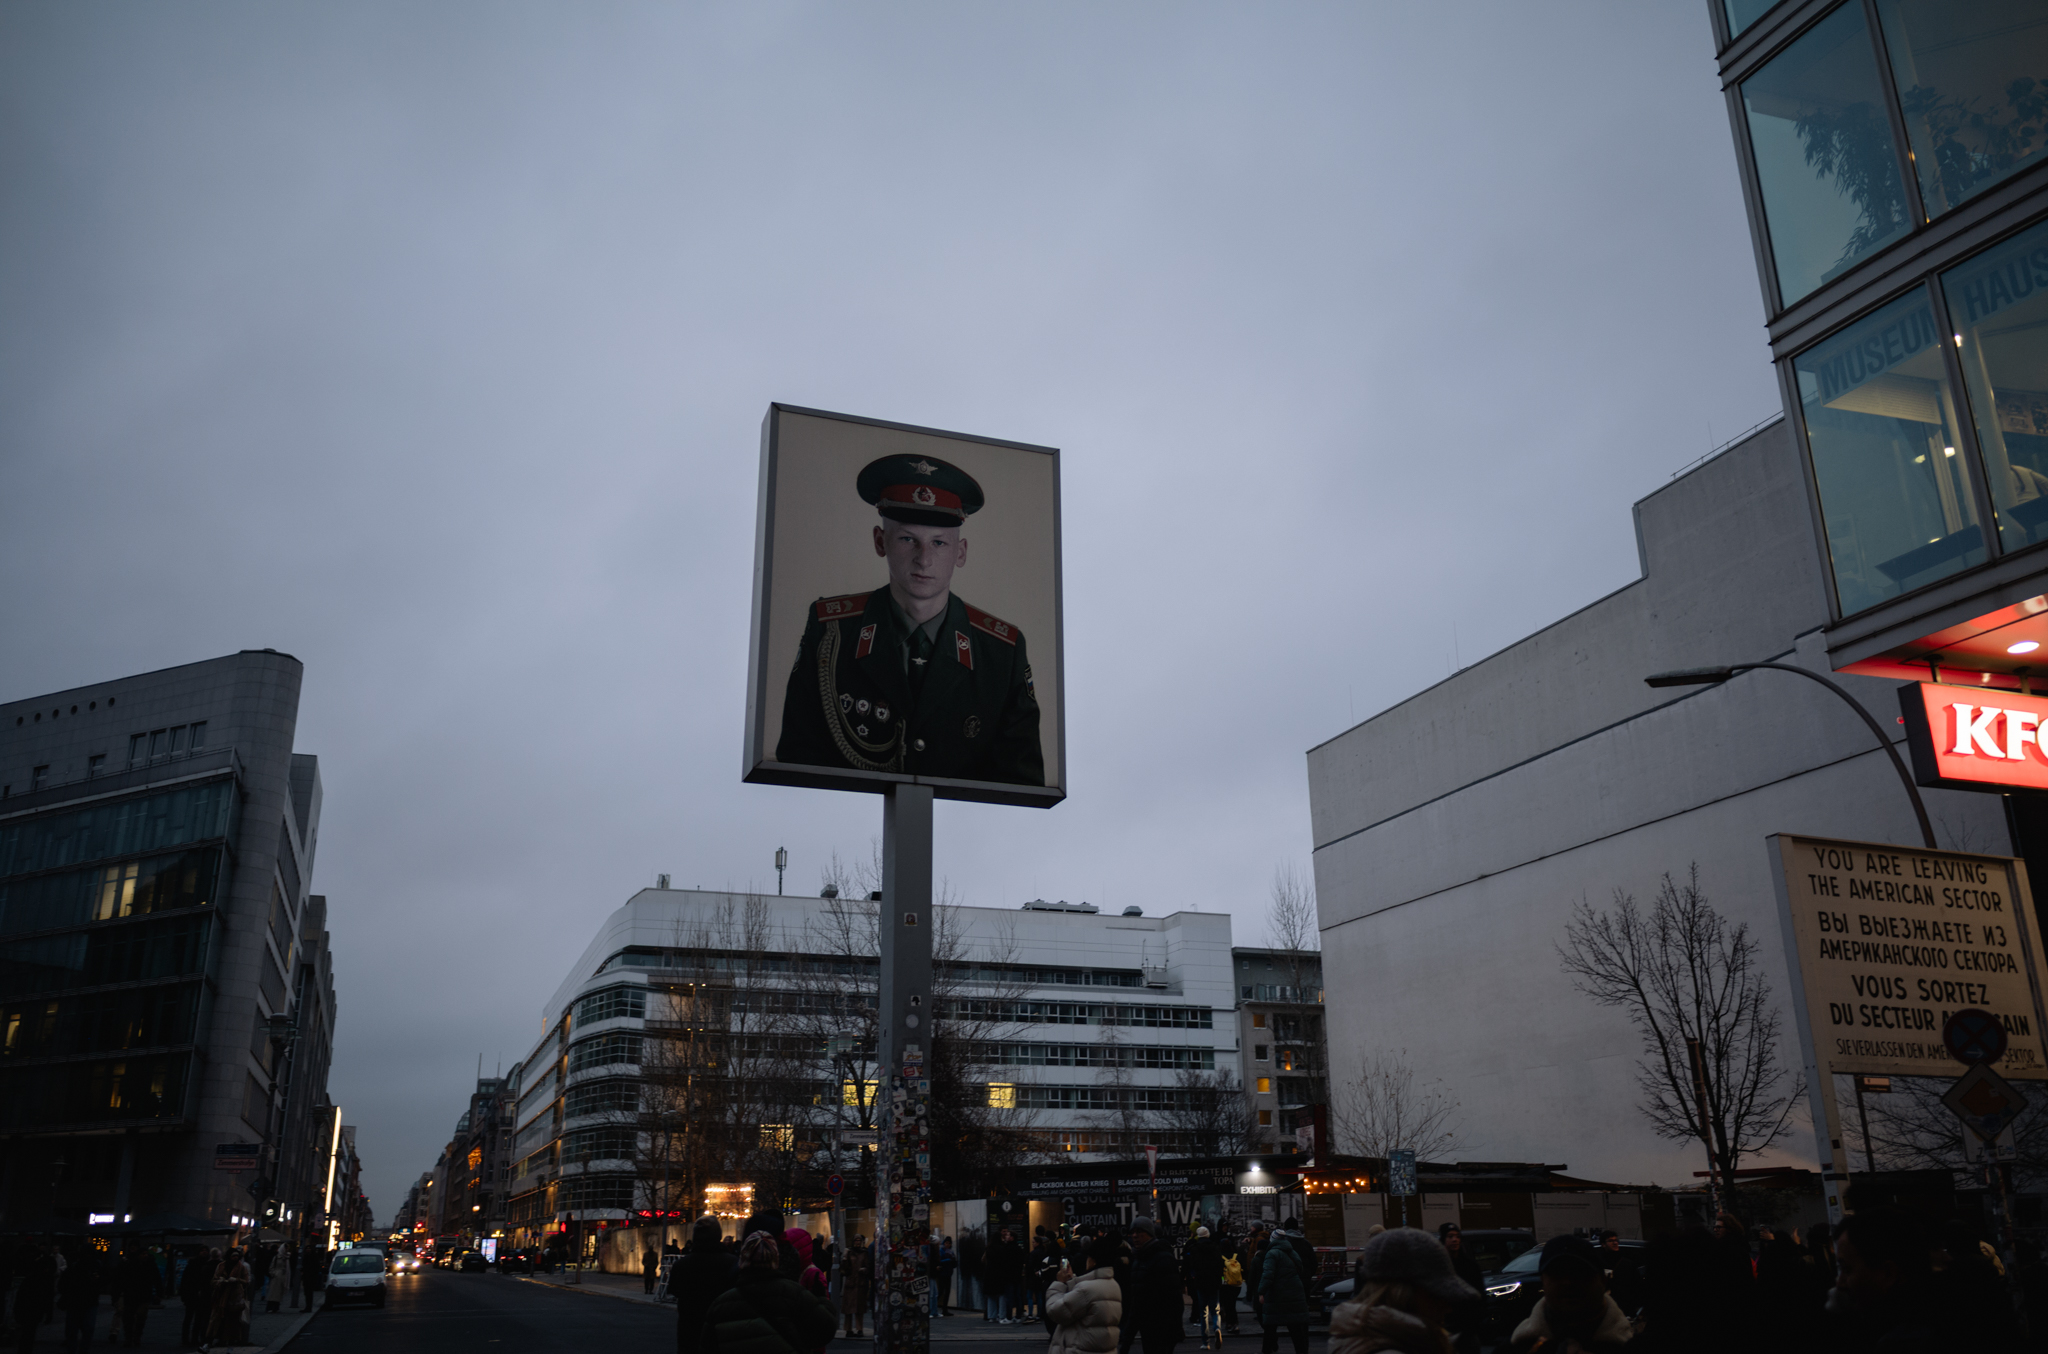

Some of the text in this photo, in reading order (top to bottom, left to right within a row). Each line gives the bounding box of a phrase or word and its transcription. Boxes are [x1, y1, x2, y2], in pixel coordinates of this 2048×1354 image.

[1963, 246, 2048, 323] HAUS
[1813, 847, 1988, 885] YOU ARE LEAVING
[1808, 874, 2003, 912] THE AMERICAN SECTOR
[1817, 911, 2007, 947] ВЫ ВЫЕЗЖАЕТЕ ИЗ
[1820, 938, 2018, 974] АМЕРИКАНСКОГО СЕКТОРА
[1851, 974, 1990, 1005] VOUS SORTEZ
[1829, 1002, 1854, 1026] DU
[1861, 1004, 1936, 1031] SECTEUR
[1836, 1038, 1852, 1055] SIE
[1853, 1040, 1904, 1059] VERLASSEN
[1906, 1044, 1924, 1059] DEN
[2005, 1048, 2036, 1064] SEKTOR
[1031, 1179, 1110, 1190] BLACKBOX KALTER KRIEG
[1153, 1177, 1172, 1185] COLD
[1213, 1176, 1235, 1186] ТОРА
[1069, 1214, 1117, 1226] CURTAIN
